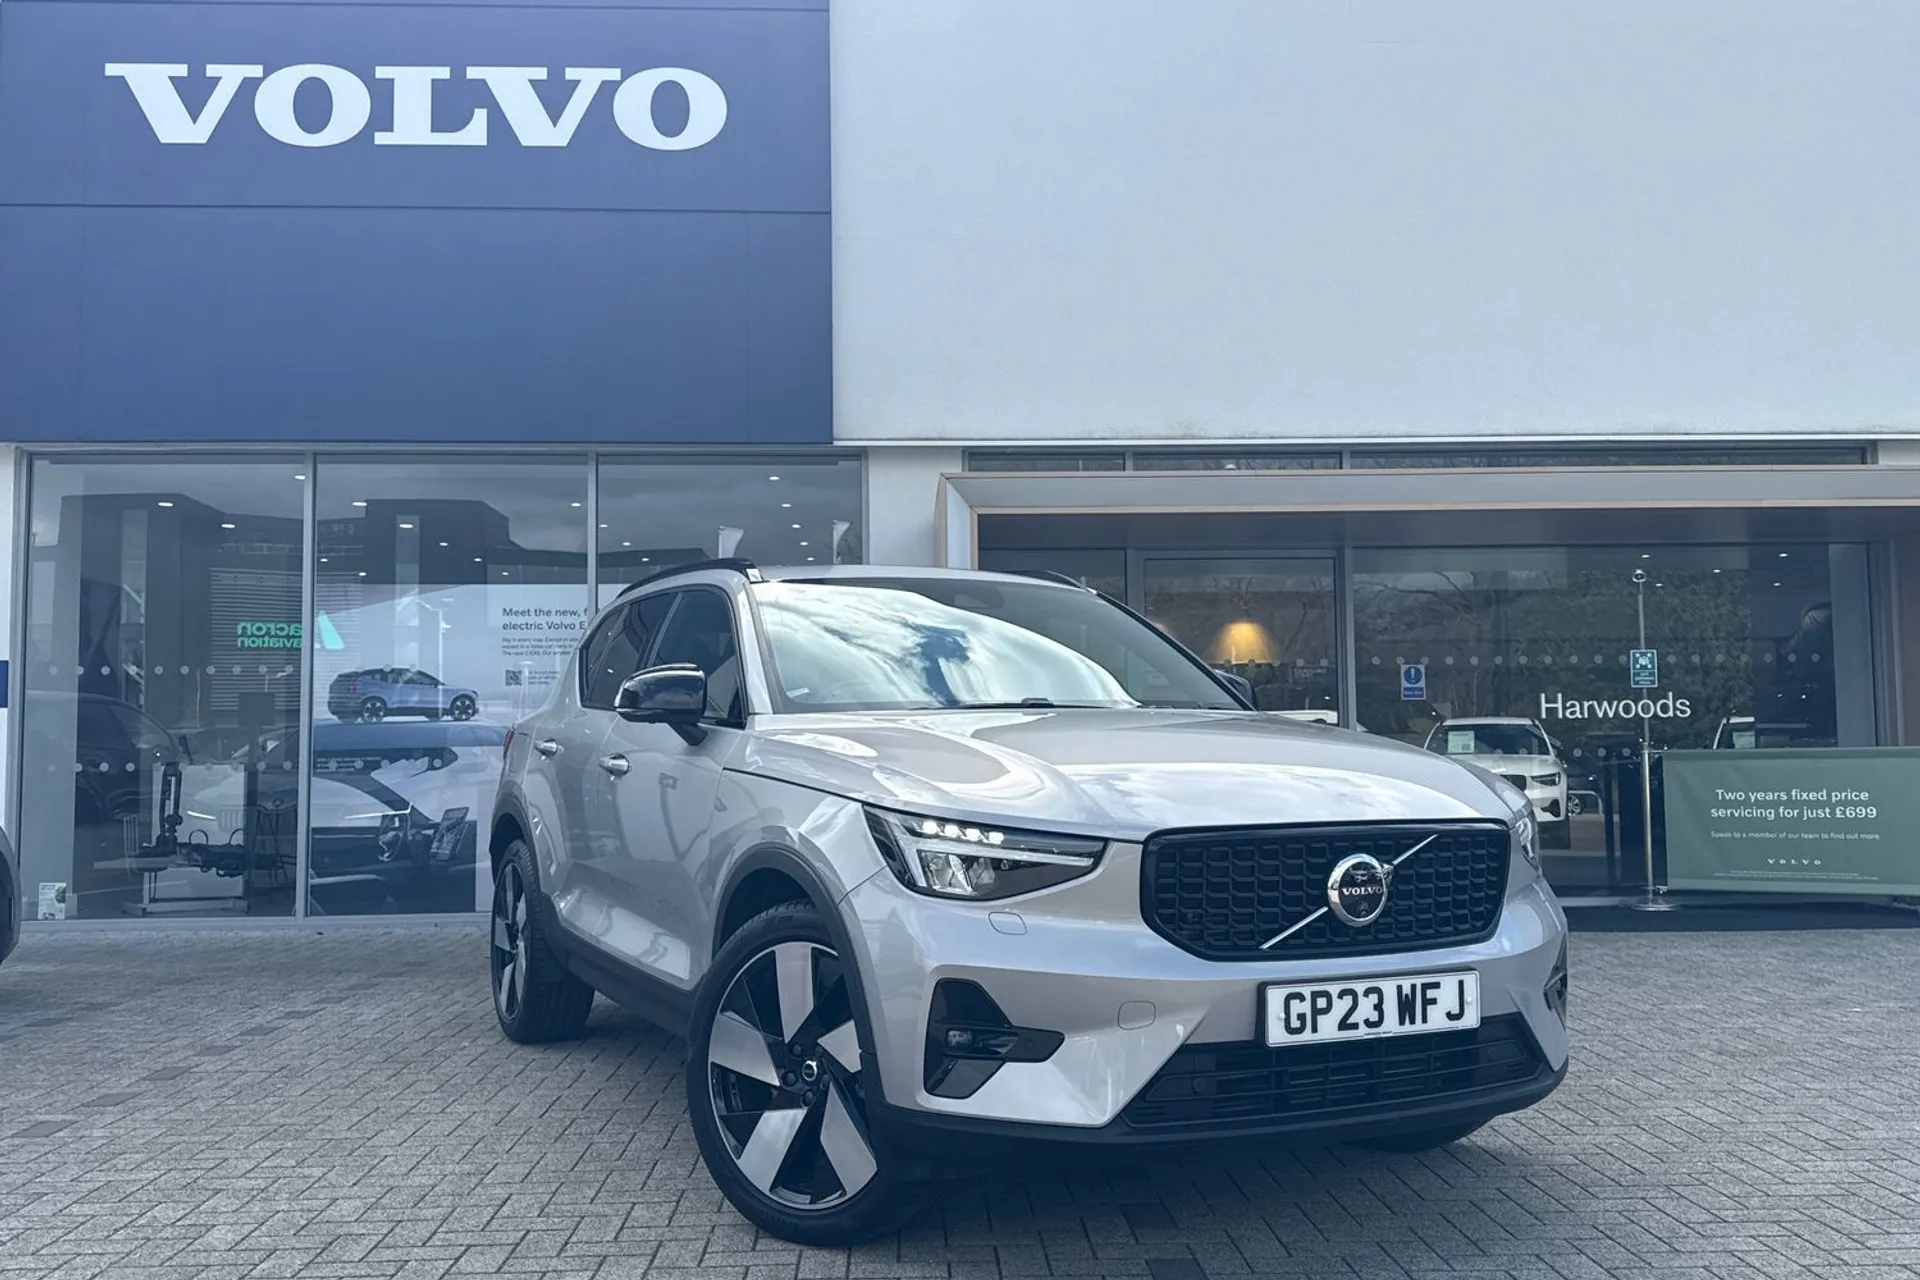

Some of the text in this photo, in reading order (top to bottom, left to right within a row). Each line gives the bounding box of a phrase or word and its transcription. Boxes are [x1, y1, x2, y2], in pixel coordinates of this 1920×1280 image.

[104, 63, 728, 151] VOLVO
[502, 608, 532, 617] Meet
[534, 608, 552, 617] the
[555, 608, 581, 618] new,
[502, 621, 543, 630] electric
[546, 621, 576, 630] Volvo
[1540, 691, 1691, 719] Harwoods
[1715, 788, 1869, 803] Two years fixed price
[1710, 805, 1877, 820] servicing for just £699
[1748, 831, 1777, 839] member
[1779, 831, 1787, 839] of
[1830, 831, 1845, 839] find
[1846, 832, 1859, 840] out
[1767, 858, 1822, 866] VOLVO
[1341, 886, 1383, 896] VOLVO
[1283, 979, 1465, 1036] GP23 WFJ
